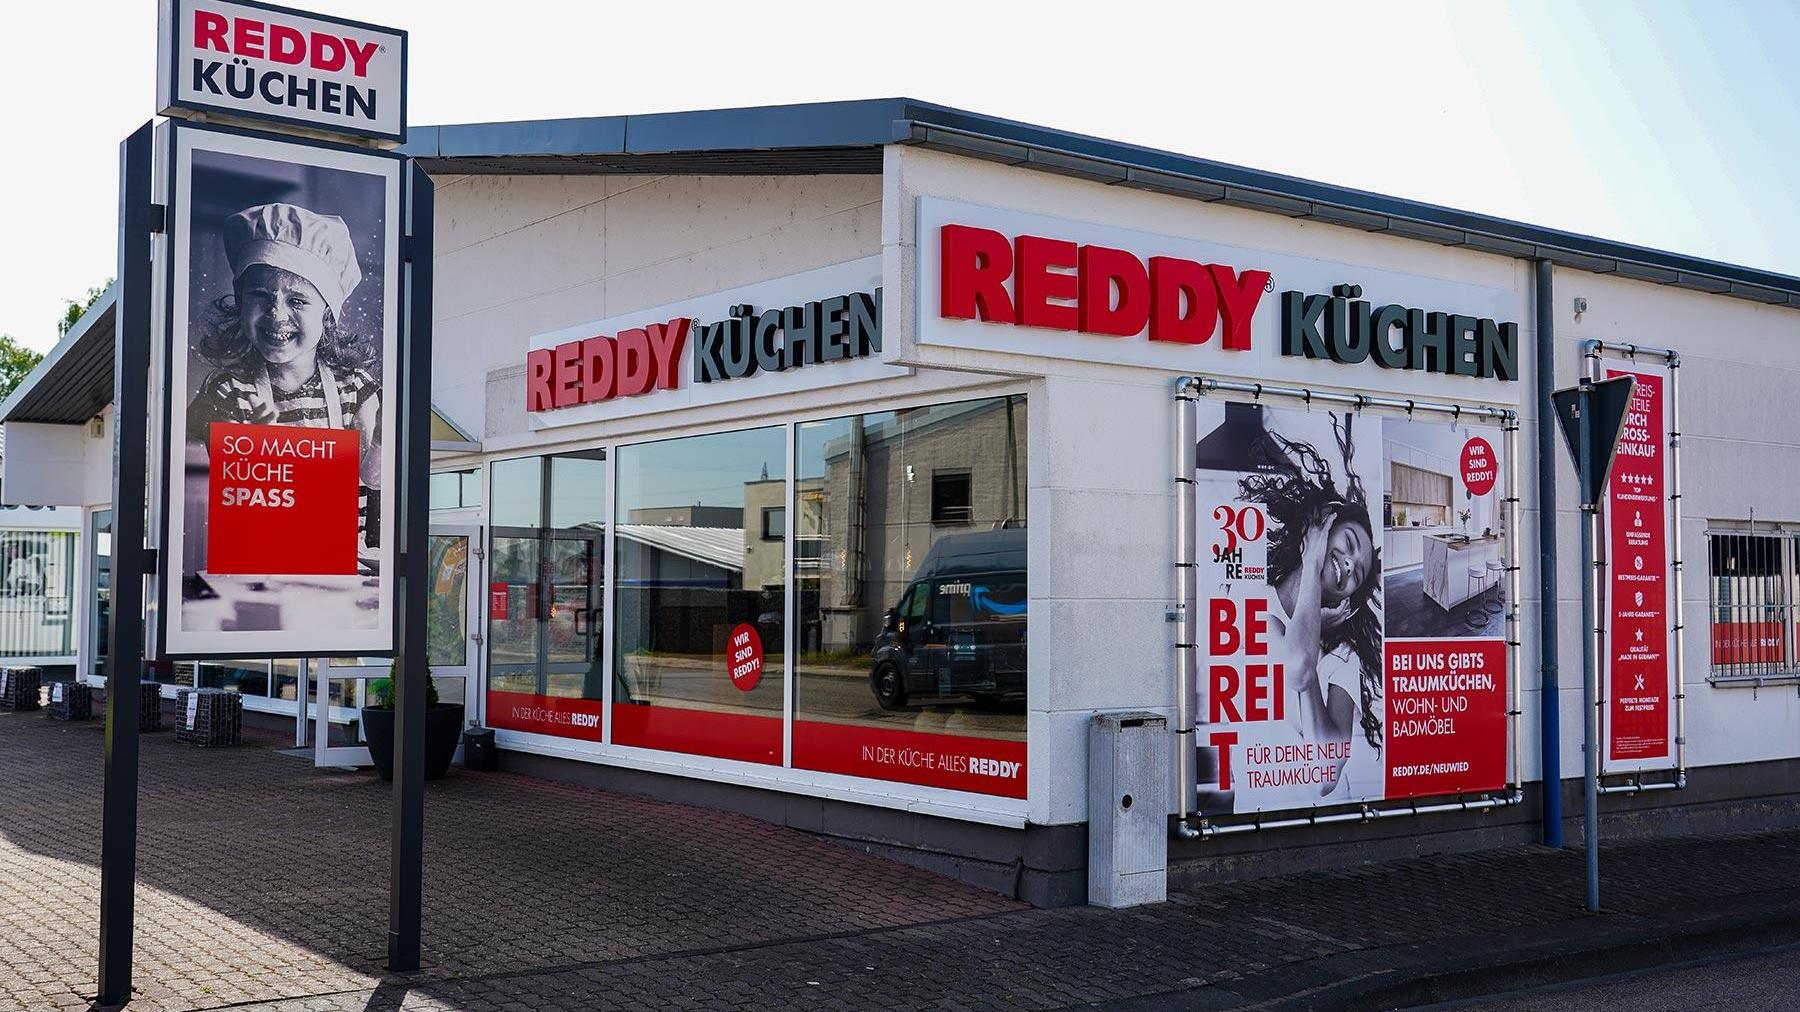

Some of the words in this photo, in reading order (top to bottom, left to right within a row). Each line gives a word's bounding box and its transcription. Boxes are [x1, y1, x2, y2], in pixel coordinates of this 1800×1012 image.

[193, 57, 377, 120] KÜCHEN
[694, 287, 883, 383] KÜCHEN
[1281, 284, 1518, 381] KÜCHEN
[222, 435, 254, 455] SO
[260, 438, 337, 459] MACHT
[1469, 445, 1485, 456] WIR
[1617, 442, 1656, 457] EINKAUF
[222, 458, 294, 482] KÜCHE
[1469, 458, 1487, 469] SIND
[1466, 470, 1493, 483] REDDY!
[222, 487, 295, 508] SPASS
[1212, 505, 1265, 556] 30
[1213, 547, 1242, 563] JAH
[1226, 563, 1243, 580] RE
[1244, 566, 1265, 574] REDDY
[1209, 598, 1268, 656] BE
[734, 631, 750, 647] WIR
[735, 645, 753, 663] SIND
[1392, 654, 1412, 671] BEI
[1416, 653, 1444, 670] UNS
[1448, 652, 1484, 670] GIBTS
[733, 657, 760, 679] REDDY!
[1392, 670, 1496, 692] TRAUMKÜCHEN,
[1209, 664, 1284, 723] REI
[512, 705, 520, 719] IN
[520, 707, 531, 720] DER
[532, 707, 553, 723] KÜCHE
[554, 710, 571, 725] ALLES
[571, 712, 600, 728] REDDY
[1392, 697, 1438, 715] WOHN-
[1441, 696, 1468, 713] UND
[1393, 715, 1456, 738] BADMÖBEL
[862, 745, 874, 761] IN
[877, 747, 895, 765] DER
[898, 747, 935, 770] KÜCHE
[937, 754, 967, 773] ALLES
[1209, 731, 1238, 790] T
[1247, 743, 1271, 765] FÜR
[1275, 743, 1313, 764] DEINE
[1317, 741, 1351, 761] NEUE
[1247, 763, 1336, 788] TRAUMKÜCHE
[1392, 761, 1469, 777] REDDY.DE/NEUWIED
